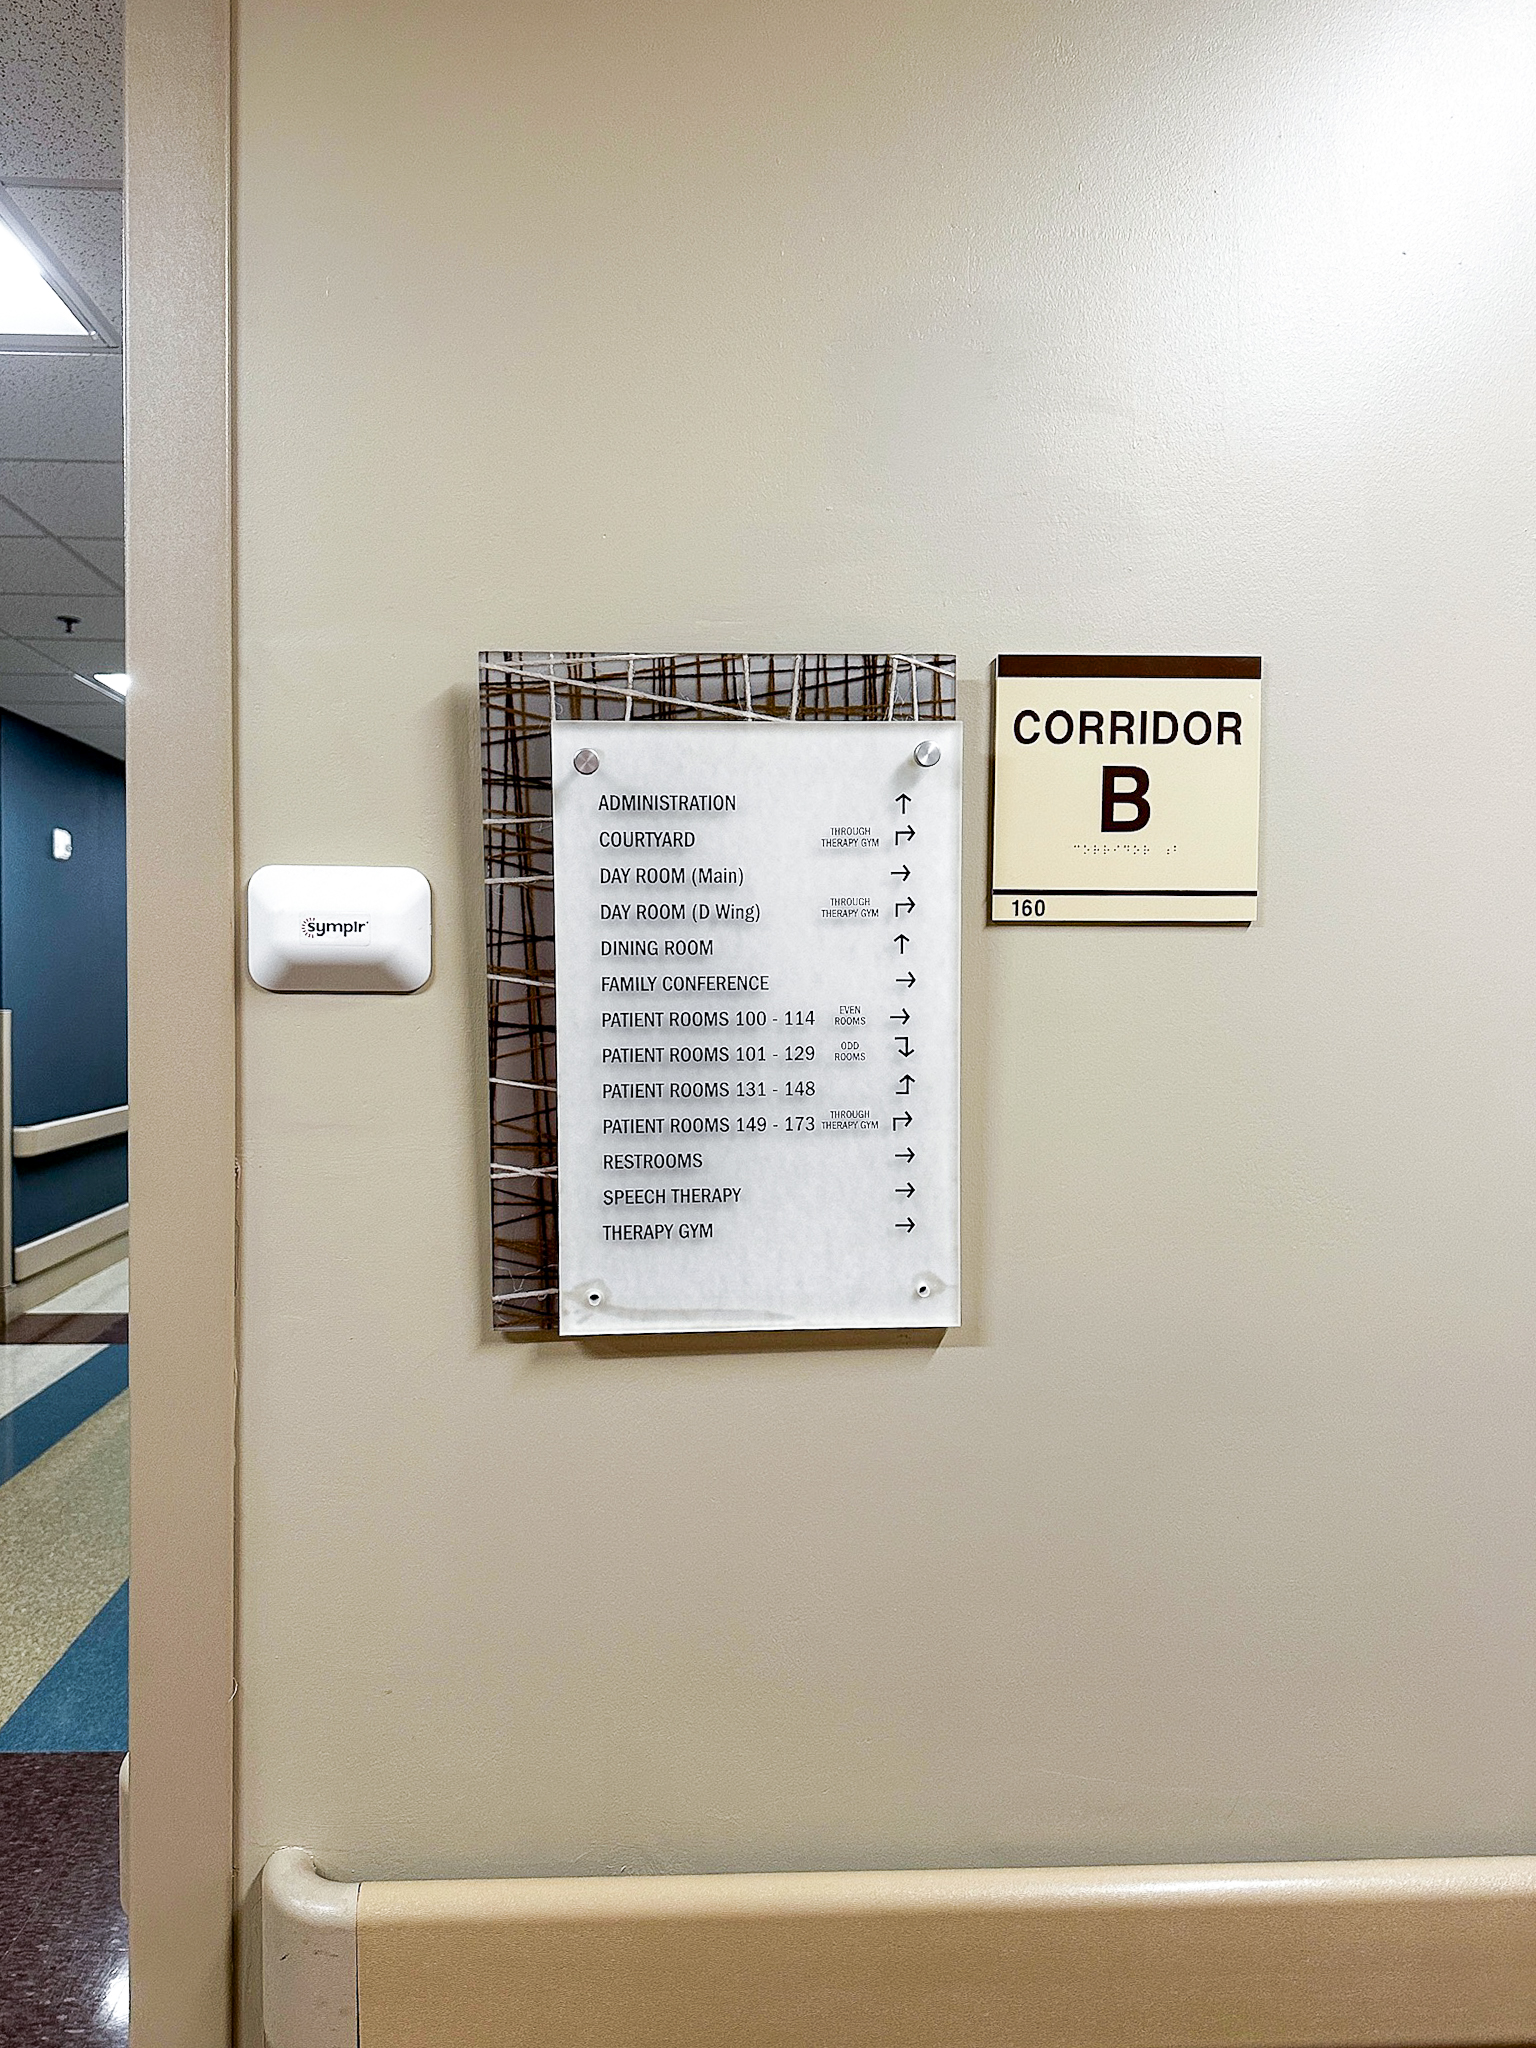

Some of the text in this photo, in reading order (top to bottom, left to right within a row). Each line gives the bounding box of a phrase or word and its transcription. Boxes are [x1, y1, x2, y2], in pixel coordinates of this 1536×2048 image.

[1013, 709, 1242, 746] CORRIDOR
[597, 794, 736, 812] ADMINISTRATION
[1100, 765, 1151, 833] B
[599, 831, 696, 848] COURTYARD
[830, 826, 871, 836] THROUGH
[820, 838, 880, 848] THERAPY GYM
[600, 867, 744, 888] DAY ROOM (Main)
[830, 897, 871, 907] THROUGH
[1011, 898, 1046, 917] 160
[600, 903, 761, 924] DAY ROOM (D Wing)
[821, 908, 879, 918] THERAPY GYM
[307, 920, 366, 938] symplr
[601, 939, 714, 956] DINING ROOM
[601, 975, 770, 992] FAMILY CONFERENCE
[601, 1011, 665, 1028] PATIENT
[669, 1011, 730, 1027] ROOMS
[736, 1010, 767, 1027] 100
[784, 1010, 816, 1026] 114
[839, 1005, 861, 1015] EVEN
[834, 1016, 866, 1026] ROOMS
[602, 1047, 665, 1064] PATIENT
[669, 1046, 730, 1063] ROOMS
[736, 1046, 767, 1062] 101
[784, 1045, 816, 1062] 129
[840, 1041, 860, 1051] ODD
[834, 1052, 866, 1062] ROOMS
[602, 1082, 665, 1099] PATIENT
[669, 1081, 730, 1099] ROOMS
[736, 1081, 767, 1097] 131
[785, 1080, 816, 1097] 148
[829, 1109, 870, 1119] THROUGH
[602, 1118, 665, 1135] PATIENT
[669, 1117, 731, 1134] ROOMS
[736, 1116, 767, 1133] 149
[784, 1116, 815, 1132] 173
[821, 1120, 879, 1130] THERAPY GYM
[603, 1152, 703, 1170] RESTROOMS
[602, 1187, 742, 1206] SPEECH THERAPY
[602, 1222, 714, 1241] THERAPY GYM
